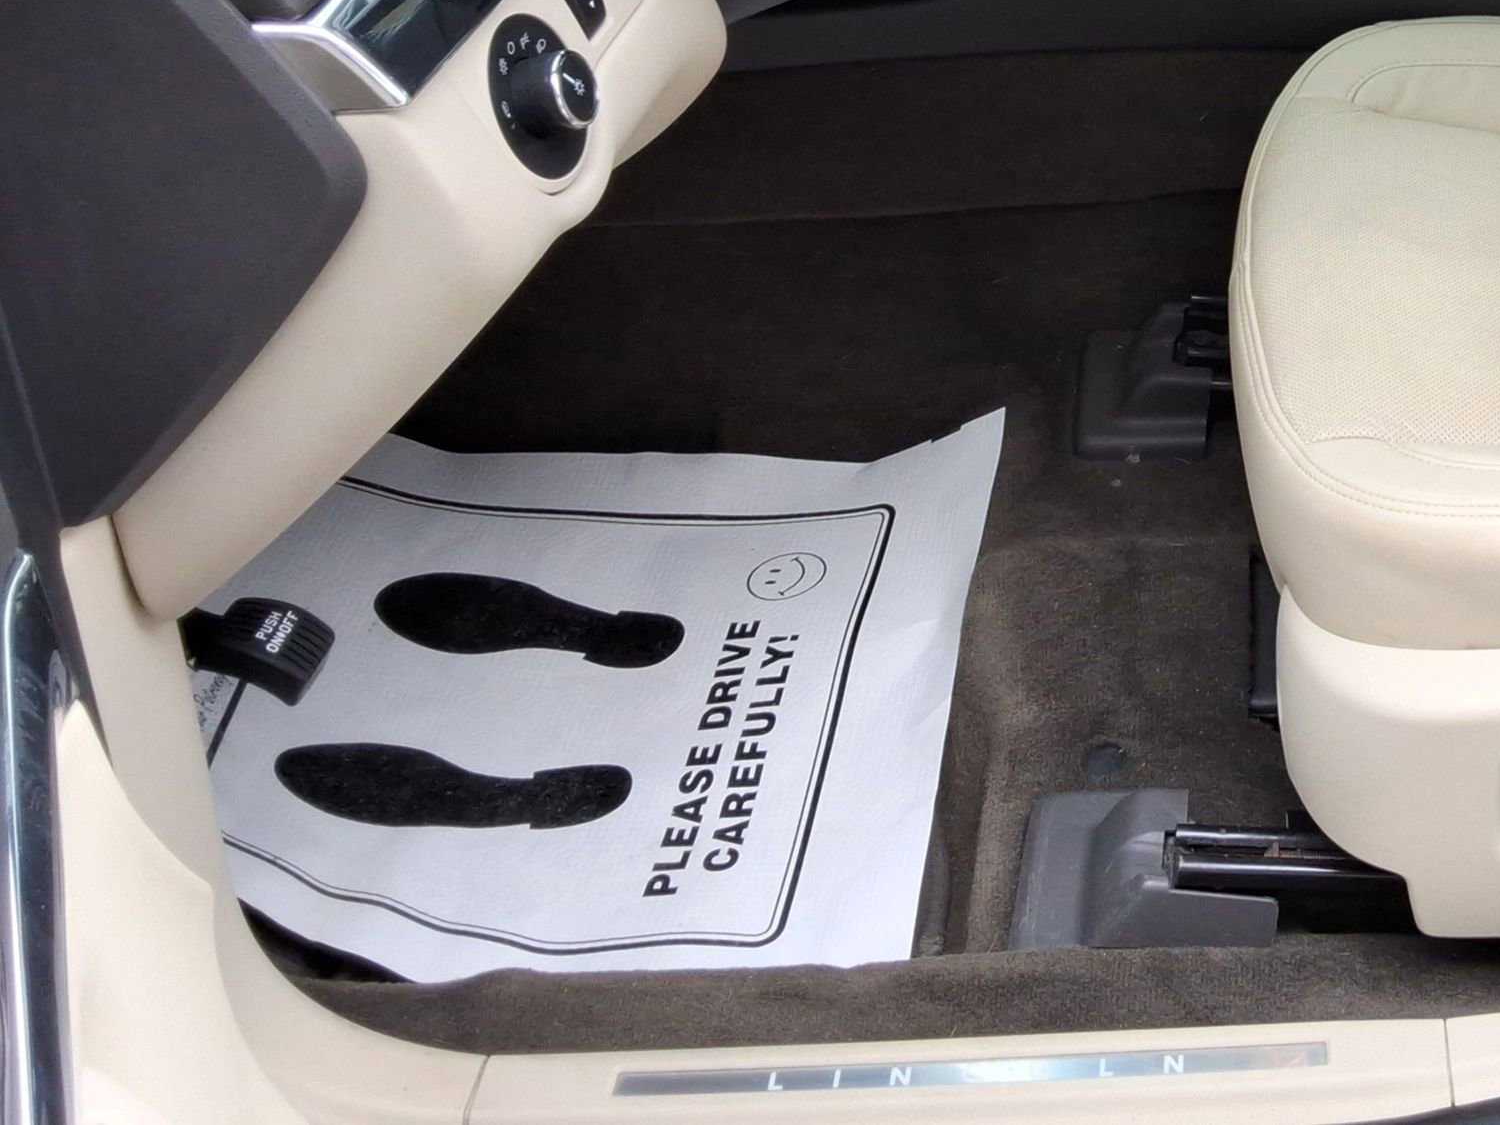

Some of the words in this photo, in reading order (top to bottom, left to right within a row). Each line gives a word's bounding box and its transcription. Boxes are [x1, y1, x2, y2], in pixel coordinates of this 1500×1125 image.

[256, 611, 282, 640] PUSH
[643, 743, 723, 897] PLEASE
[698, 620, 761, 730] DRIVE
[703, 635, 799, 871] CAREFULLY!
[767, 1054, 1186, 1092] LINLN
